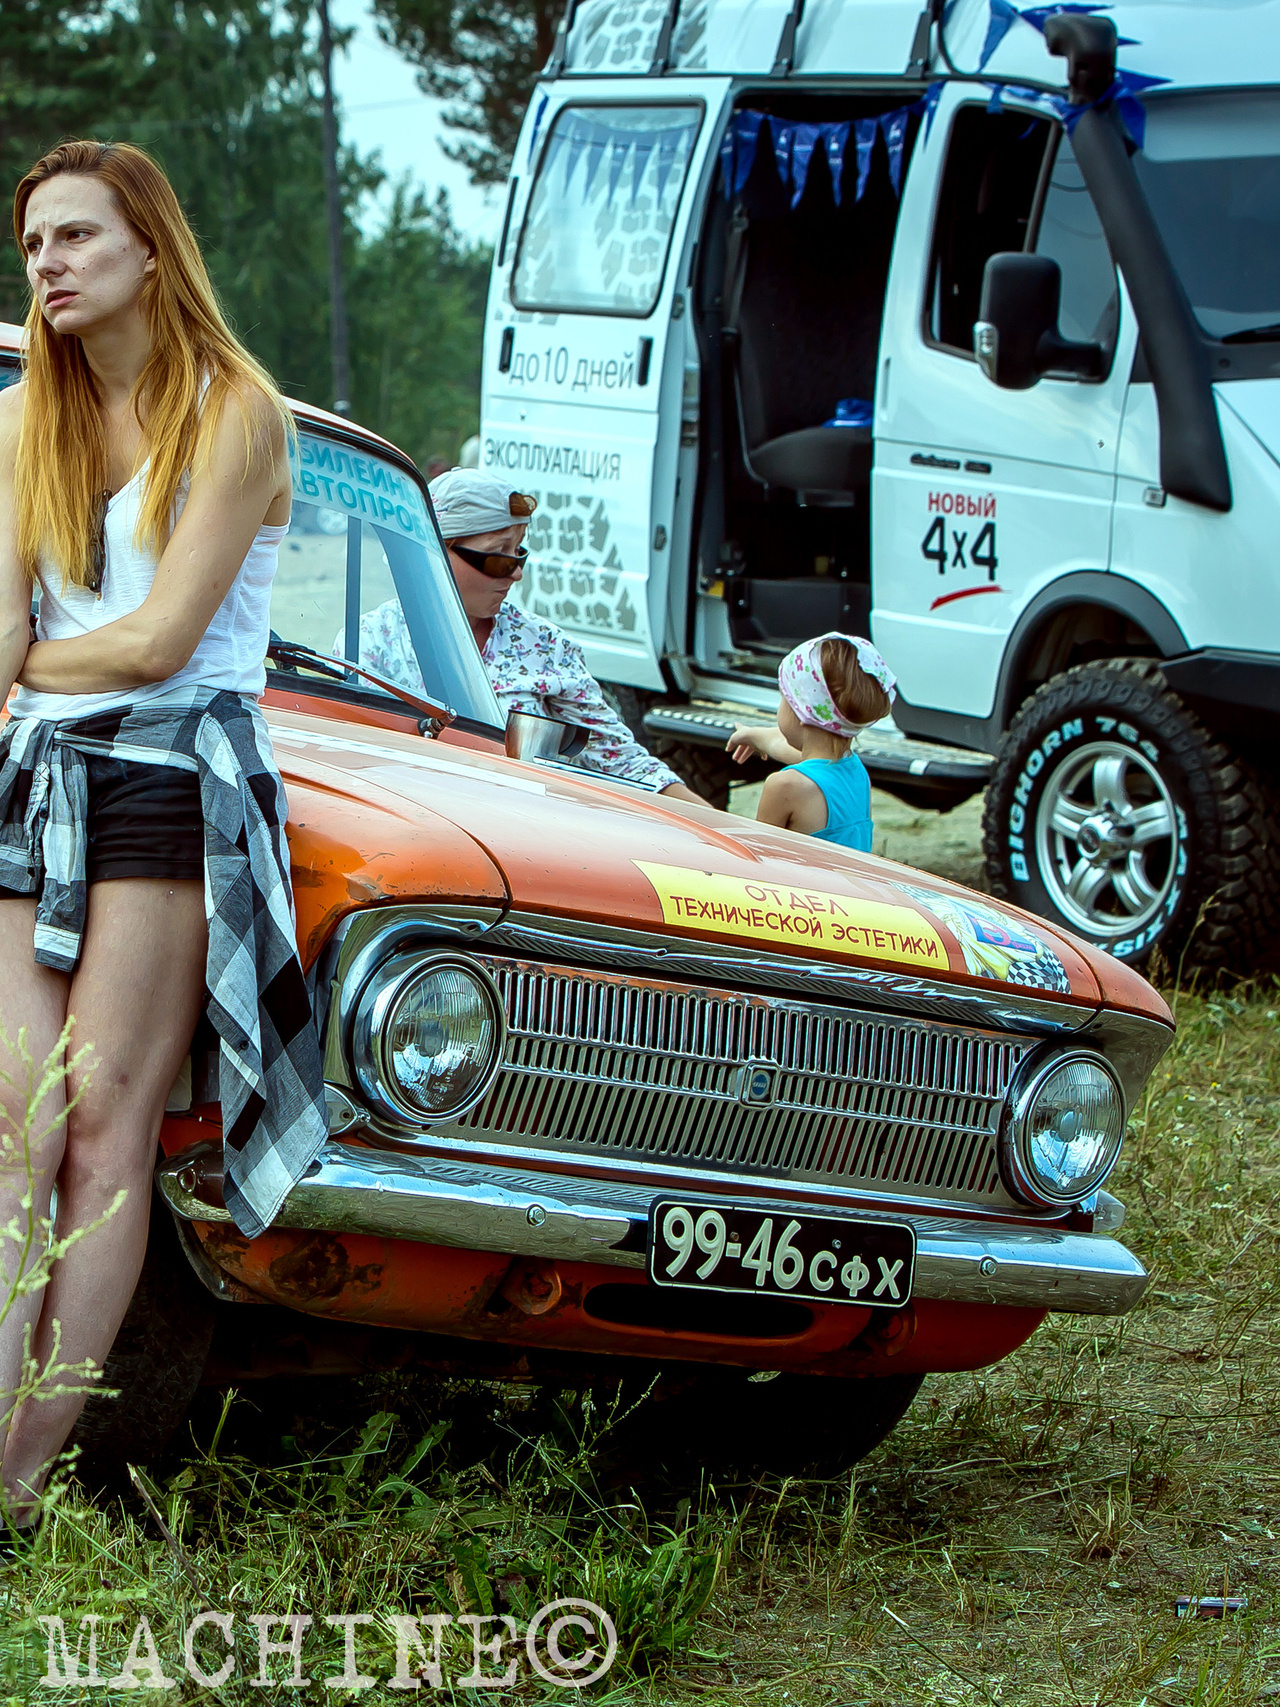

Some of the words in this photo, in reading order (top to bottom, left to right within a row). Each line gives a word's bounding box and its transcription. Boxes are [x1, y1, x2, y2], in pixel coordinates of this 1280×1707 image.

[509, 352, 540, 385] до
[544, 346, 569, 385] 10
[572, 351, 634, 392] дней
[484, 438, 622, 482] ЭКСПЛУАТАЦИЯ
[928, 490, 997, 518] НОВЫЙ
[1008, 717, 1085, 882] BIGHORN
[744, 884, 849, 918] ОТДЕЛ
[670, 895, 824, 939] ТЕХНИЧЕСКОЙ
[831, 923, 940, 959] ЭСТЕТИКИ
